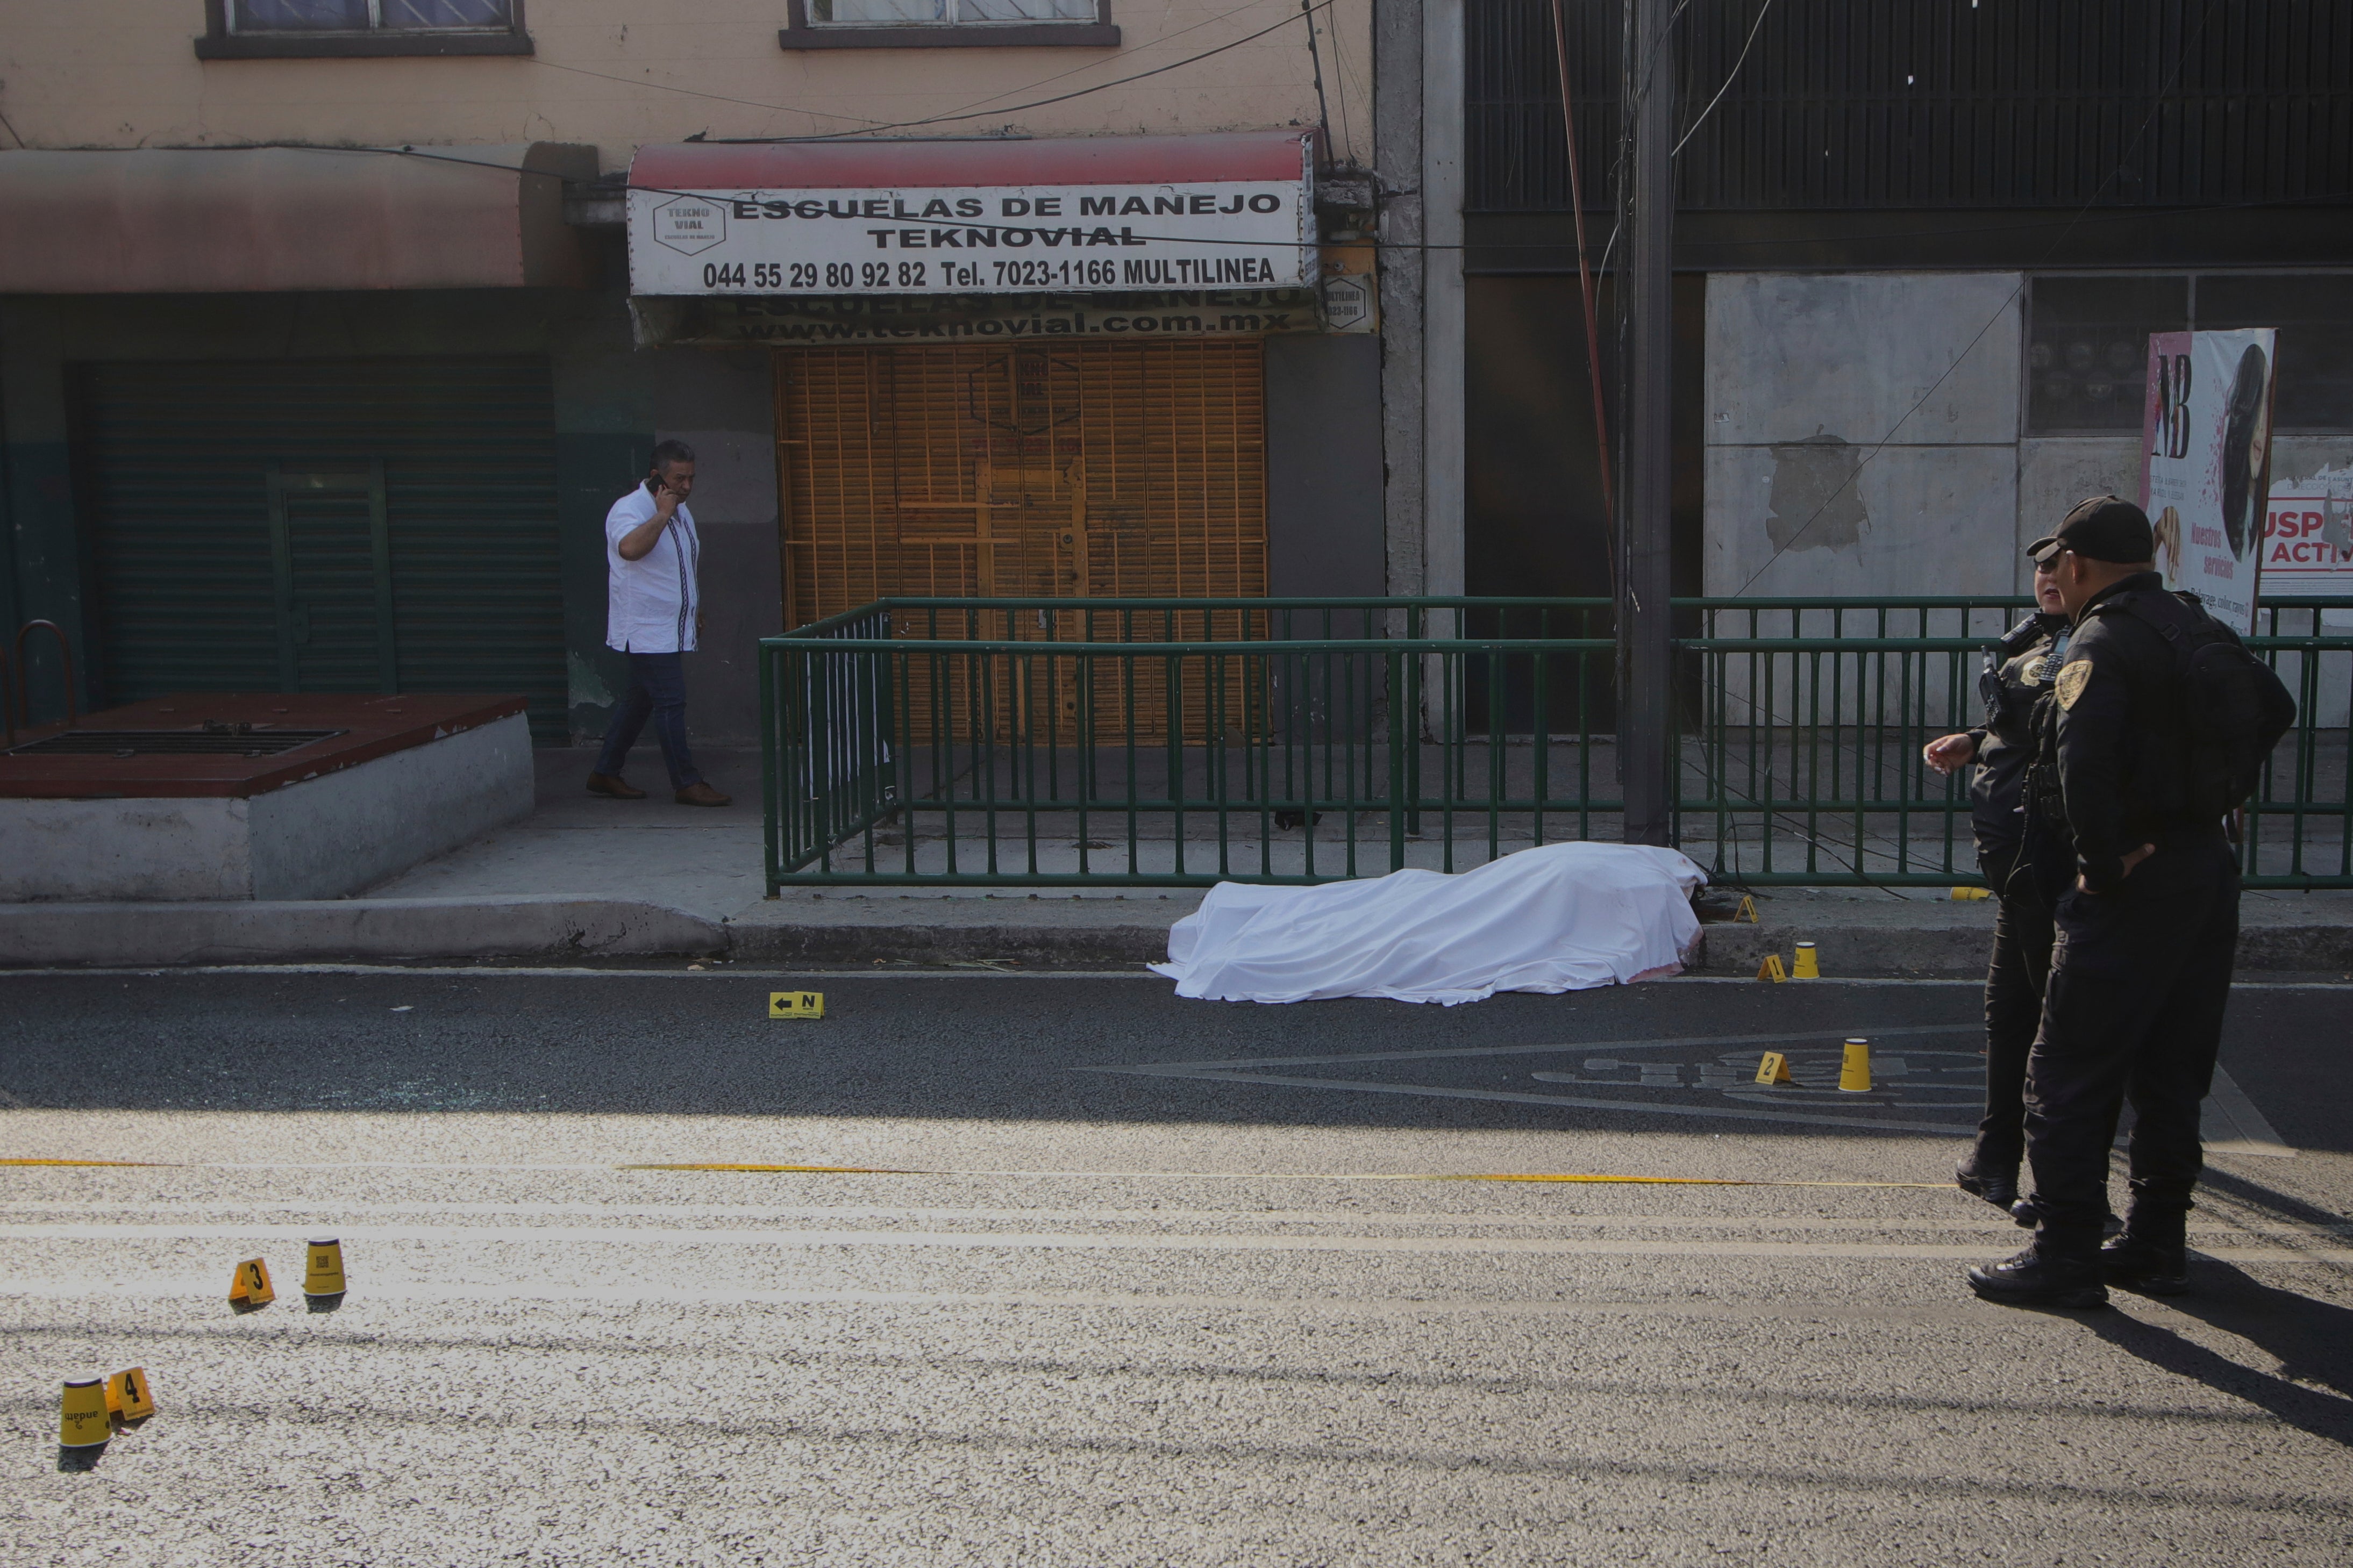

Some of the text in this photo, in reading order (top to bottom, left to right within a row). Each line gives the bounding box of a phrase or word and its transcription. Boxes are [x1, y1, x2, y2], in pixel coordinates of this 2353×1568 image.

[667, 208, 710, 218] TEKNO
[733, 194, 1281, 219] ESCUELAS DE MANEJO
[674, 220, 704, 230] VIAL
[867, 226, 1147, 248] TEKNOVIAL
[703, 258, 1275, 288] 044 55 29 80 92 82 Tel. 7023-1166 MULTILINEA
[739, 312, 1292, 340] www.teknovial.com.mx
[2191, 522, 2222, 548] Nuestros
[2204, 555, 2234, 580] servicios
[1772, 959, 1780, 976] 1
[802, 994, 815, 1008] N
[1763, 1057, 1774, 1076] 2
[249, 1263, 263, 1290] 3
[125, 1373, 140, 1404] 4
[64, 1410, 99, 1422] andatti
